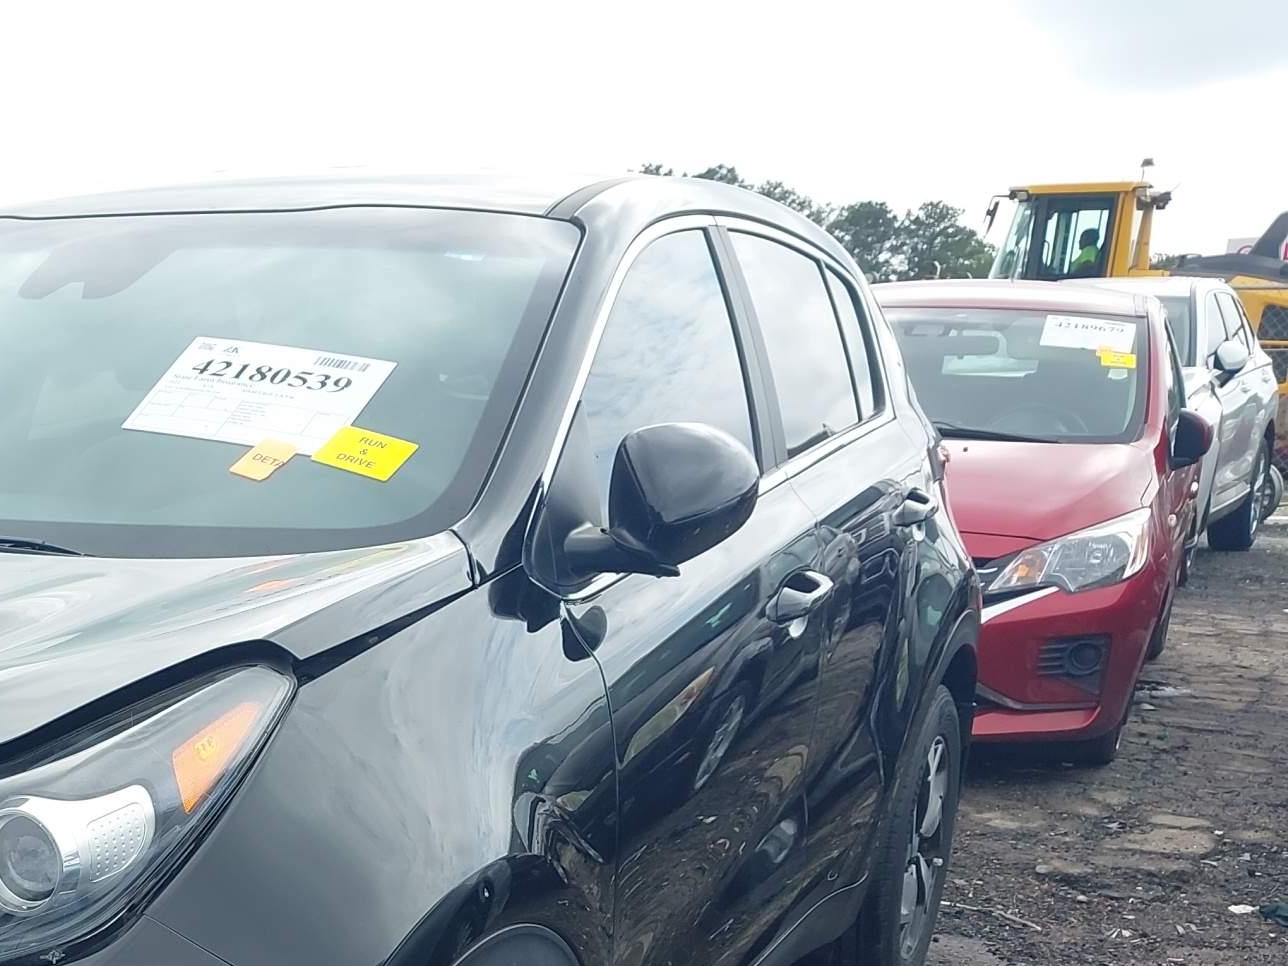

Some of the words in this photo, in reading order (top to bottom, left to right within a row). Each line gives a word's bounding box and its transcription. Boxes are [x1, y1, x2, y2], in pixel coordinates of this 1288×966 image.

[192, 358, 353, 394] 42180539
[359, 436, 387, 449] RUN
[359, 448, 368, 456] &
[336, 452, 376, 469] DRIVE
